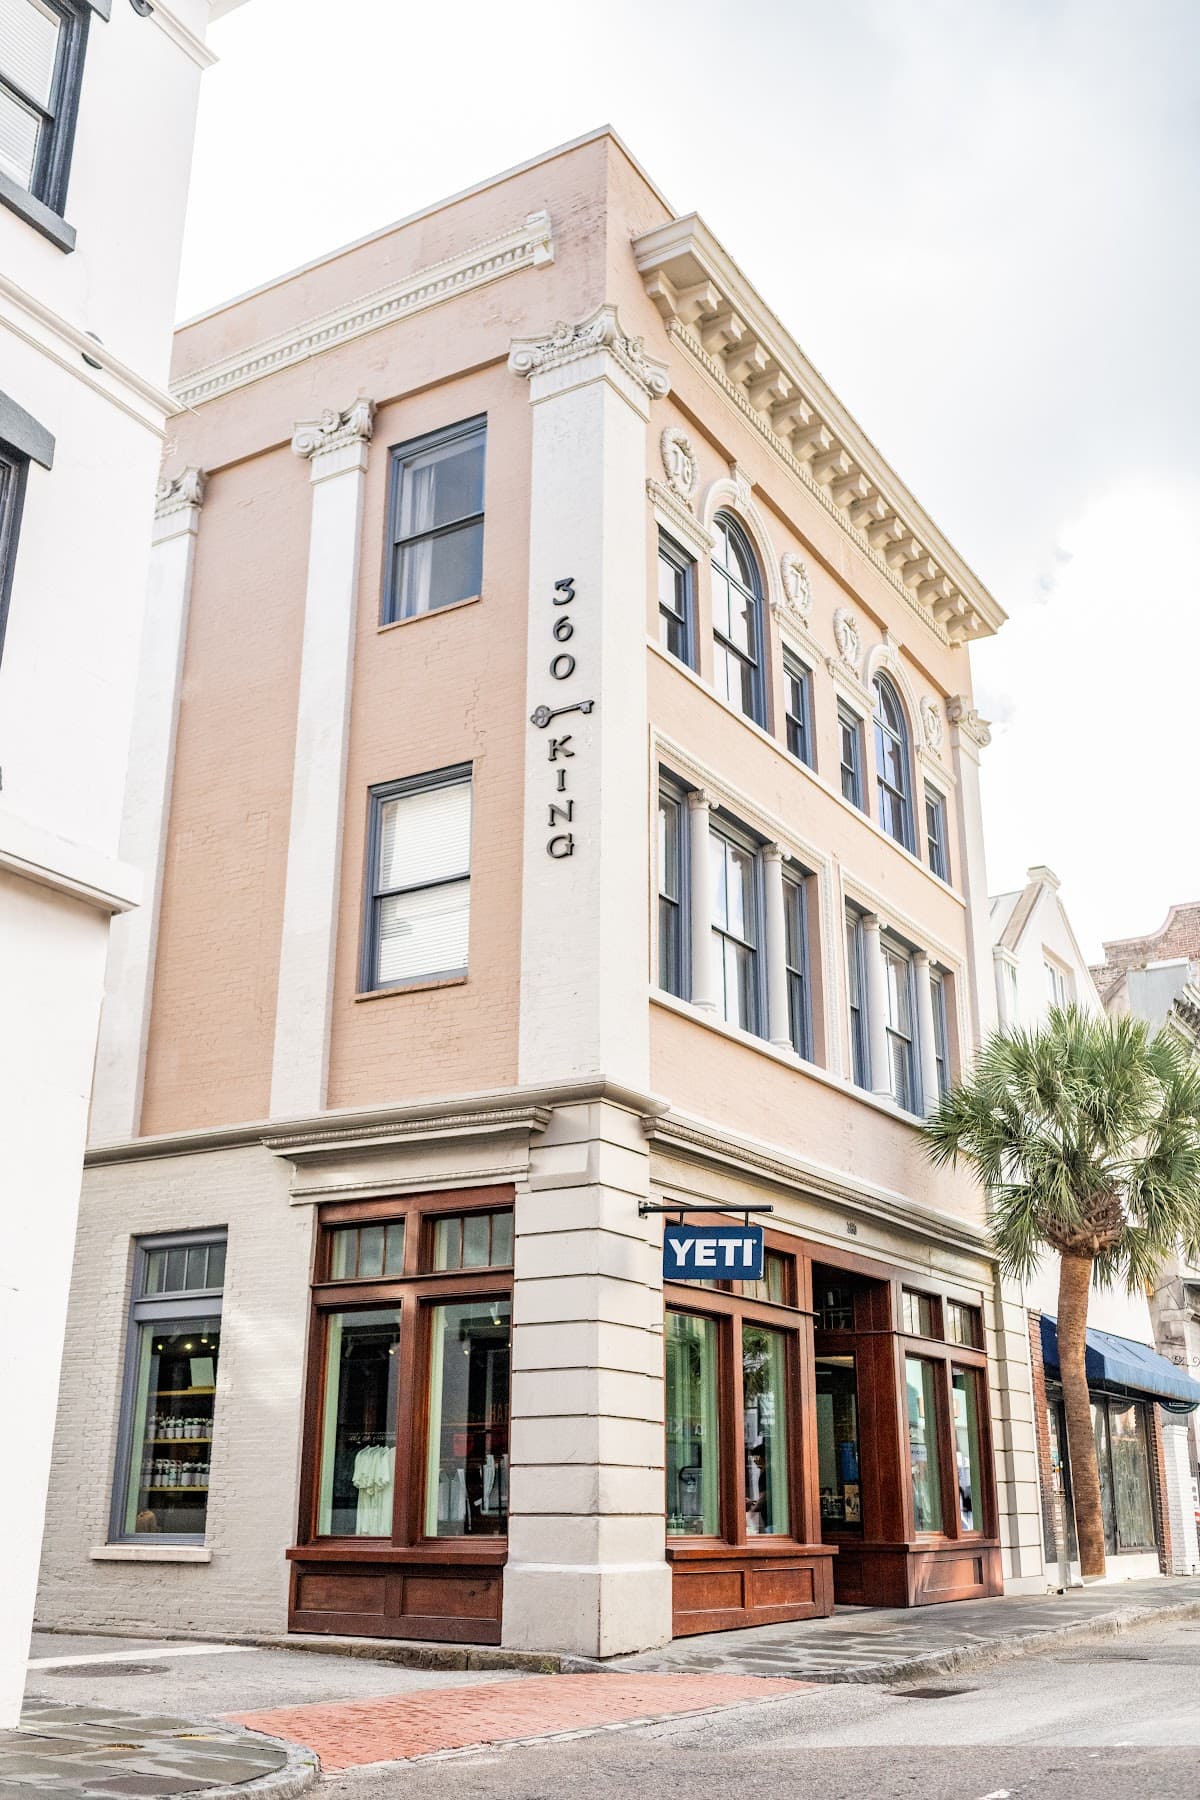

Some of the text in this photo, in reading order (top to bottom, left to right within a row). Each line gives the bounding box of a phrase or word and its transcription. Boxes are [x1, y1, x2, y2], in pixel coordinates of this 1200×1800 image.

[546, 577, 576, 859] 360 KING
[668, 1238, 753, 1267] YETI
